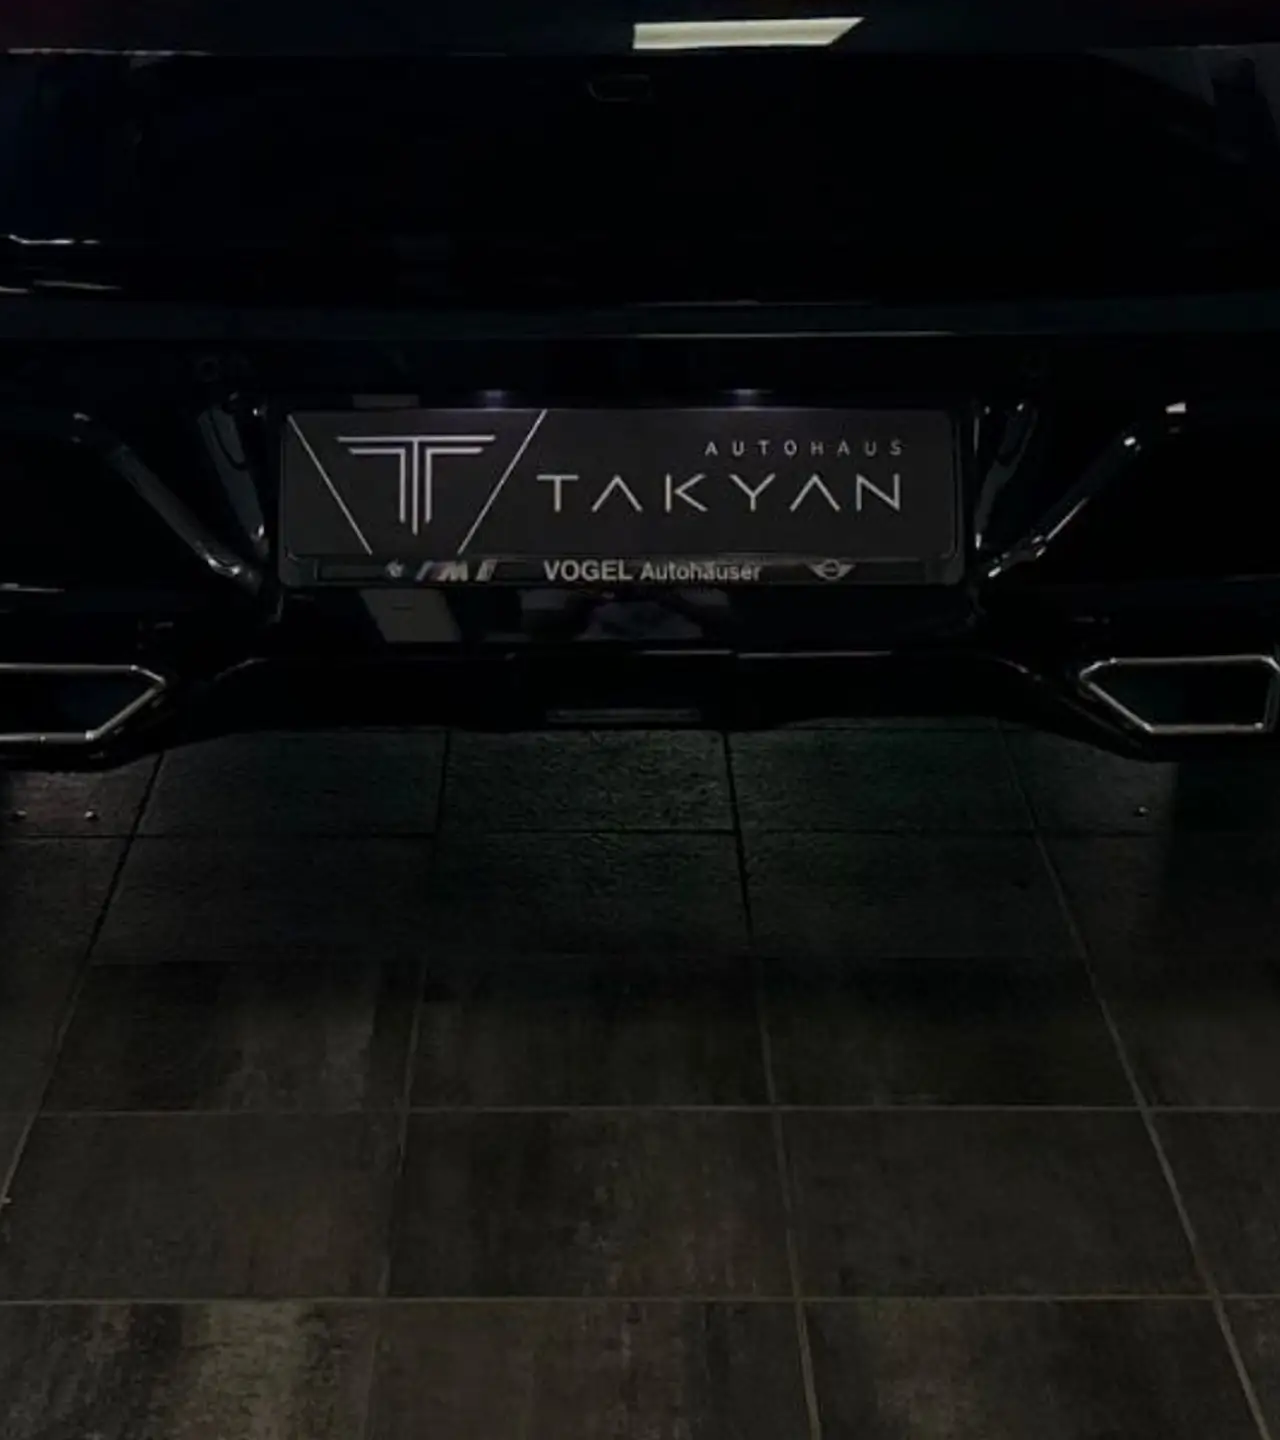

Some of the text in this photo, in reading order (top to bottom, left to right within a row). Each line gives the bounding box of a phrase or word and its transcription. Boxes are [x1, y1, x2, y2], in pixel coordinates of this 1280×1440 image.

[705, 441, 904, 456] AUTOHAUS
[536, 474, 902, 513] TAKYAN
[543, 559, 633, 582] VOGEL
